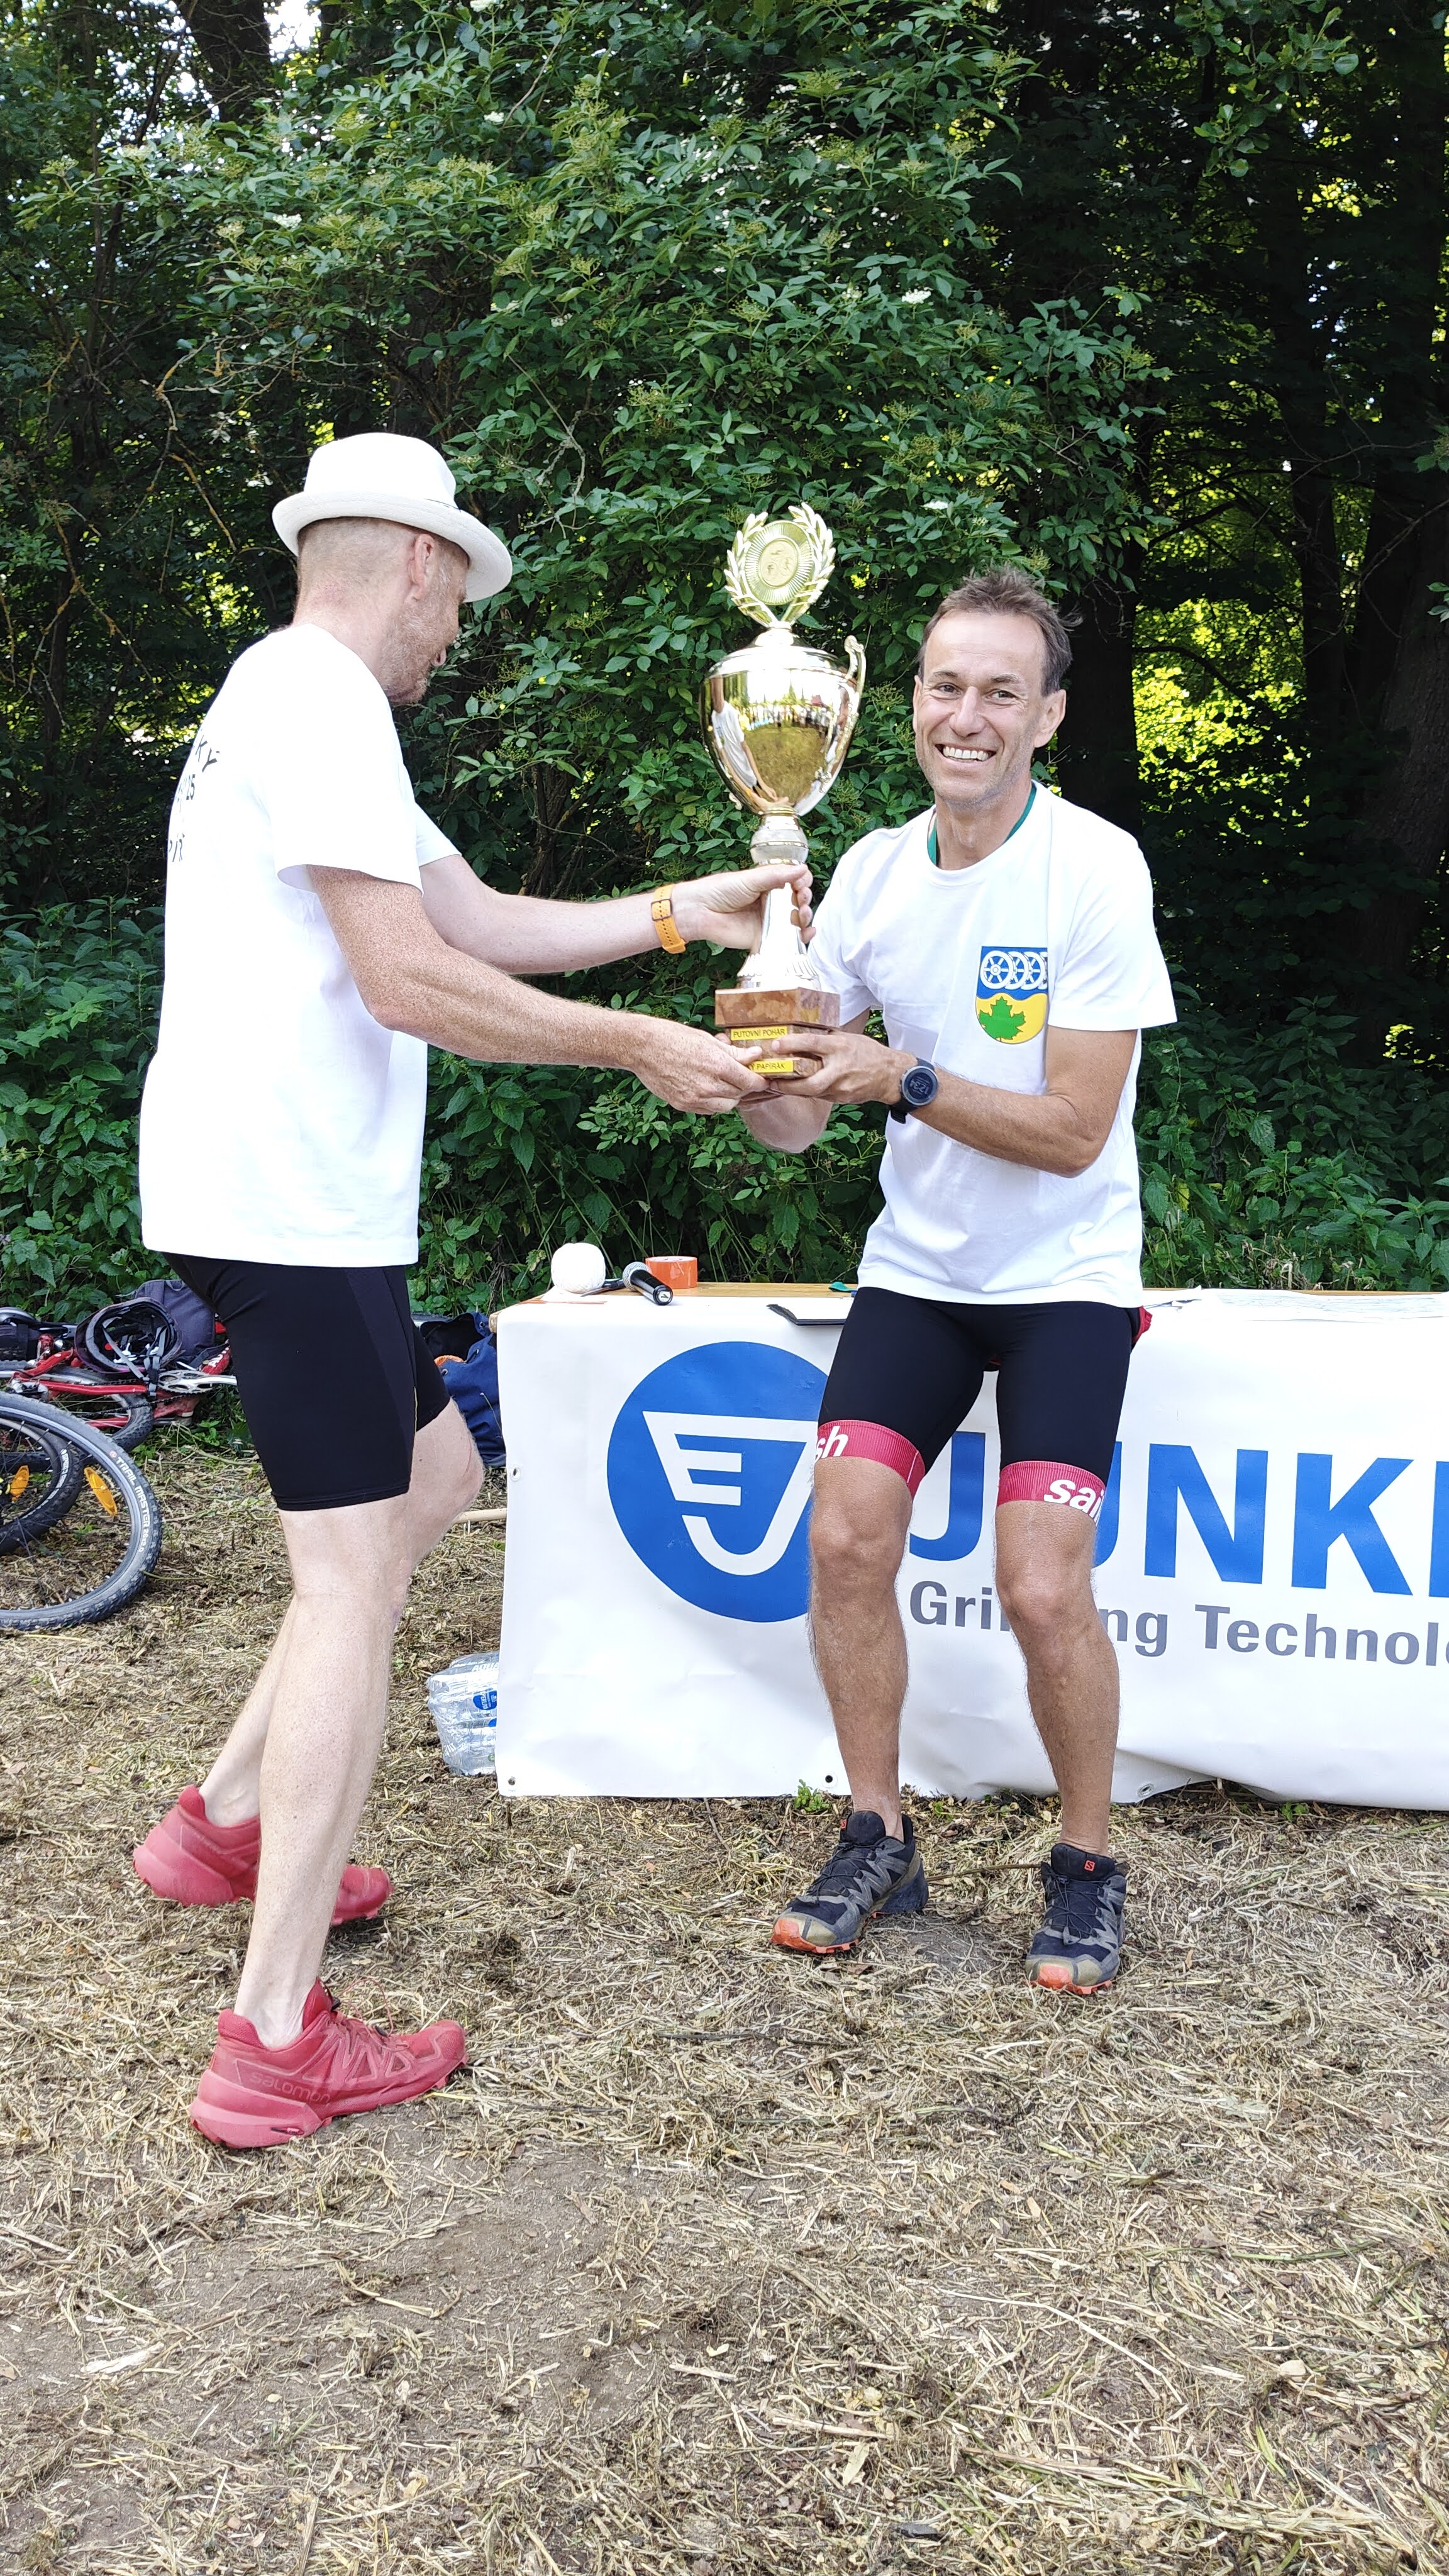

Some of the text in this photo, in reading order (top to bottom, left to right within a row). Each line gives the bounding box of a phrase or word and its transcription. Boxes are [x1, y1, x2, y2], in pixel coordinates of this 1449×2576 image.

[115, 1456, 137, 1487] TRAIL
[135, 1485, 151, 1528] MASTER
[910, 1431, 1449, 1597] JNK
[909, 1580, 1449, 1667] Gring Technol
